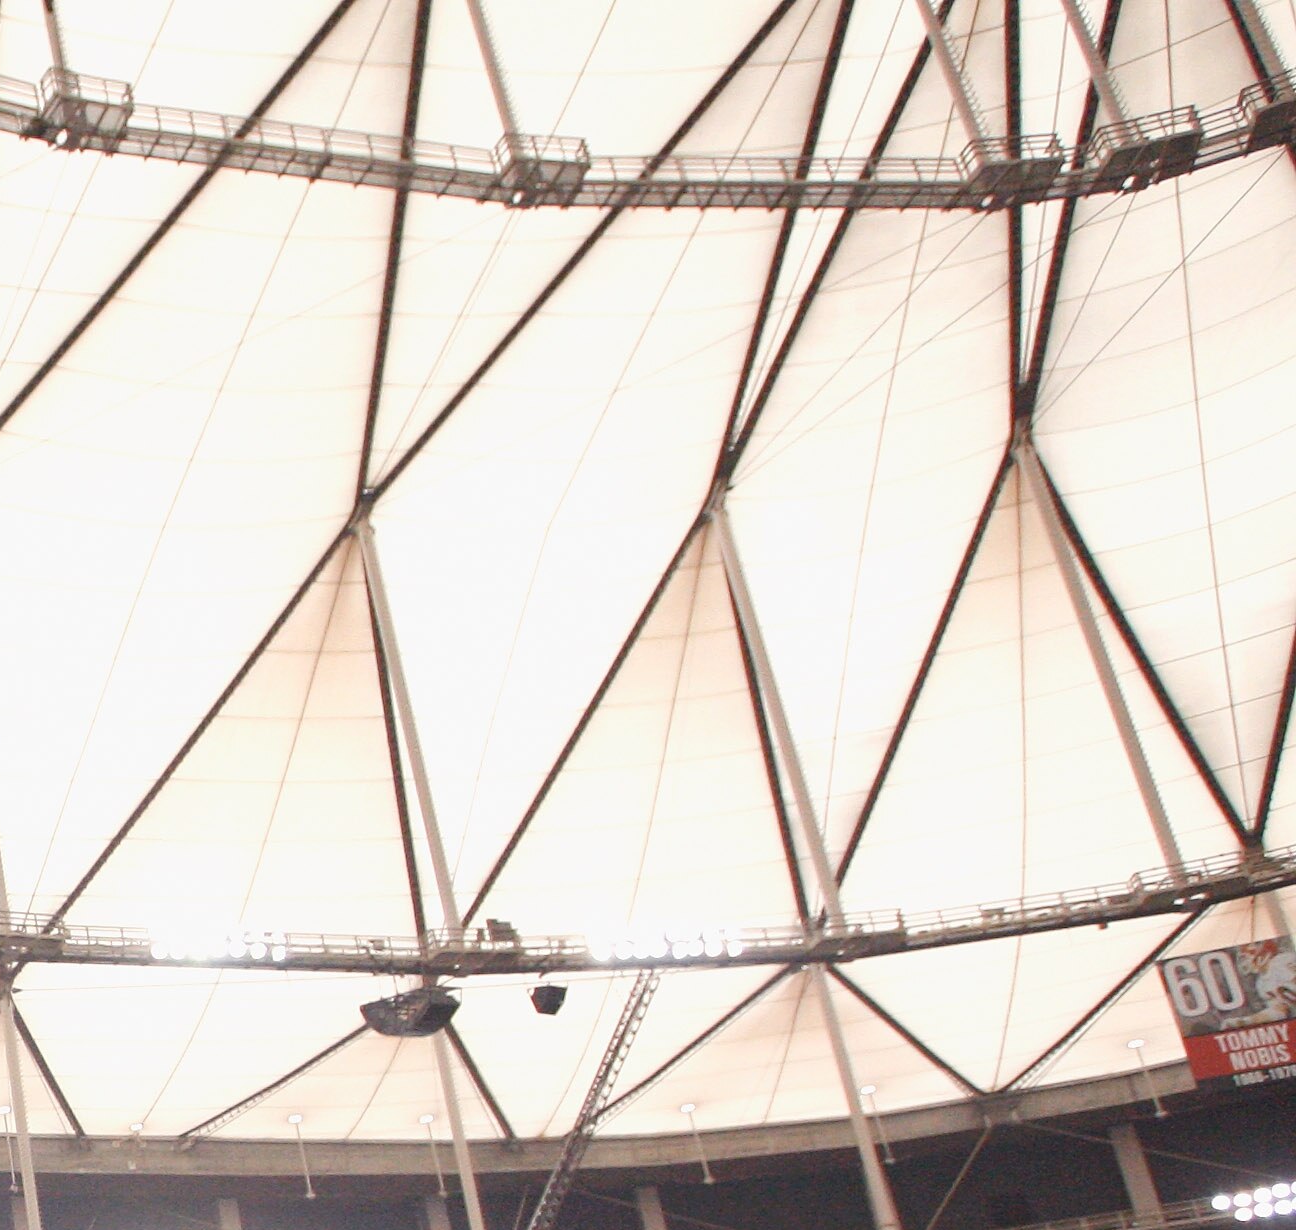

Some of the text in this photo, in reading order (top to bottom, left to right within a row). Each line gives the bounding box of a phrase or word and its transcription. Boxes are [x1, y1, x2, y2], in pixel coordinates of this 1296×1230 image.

[1164, 951, 1244, 1017] 60
[1214, 1023, 1289, 1053] TOMMY
[1229, 1044, 1292, 1071] NOBIS
